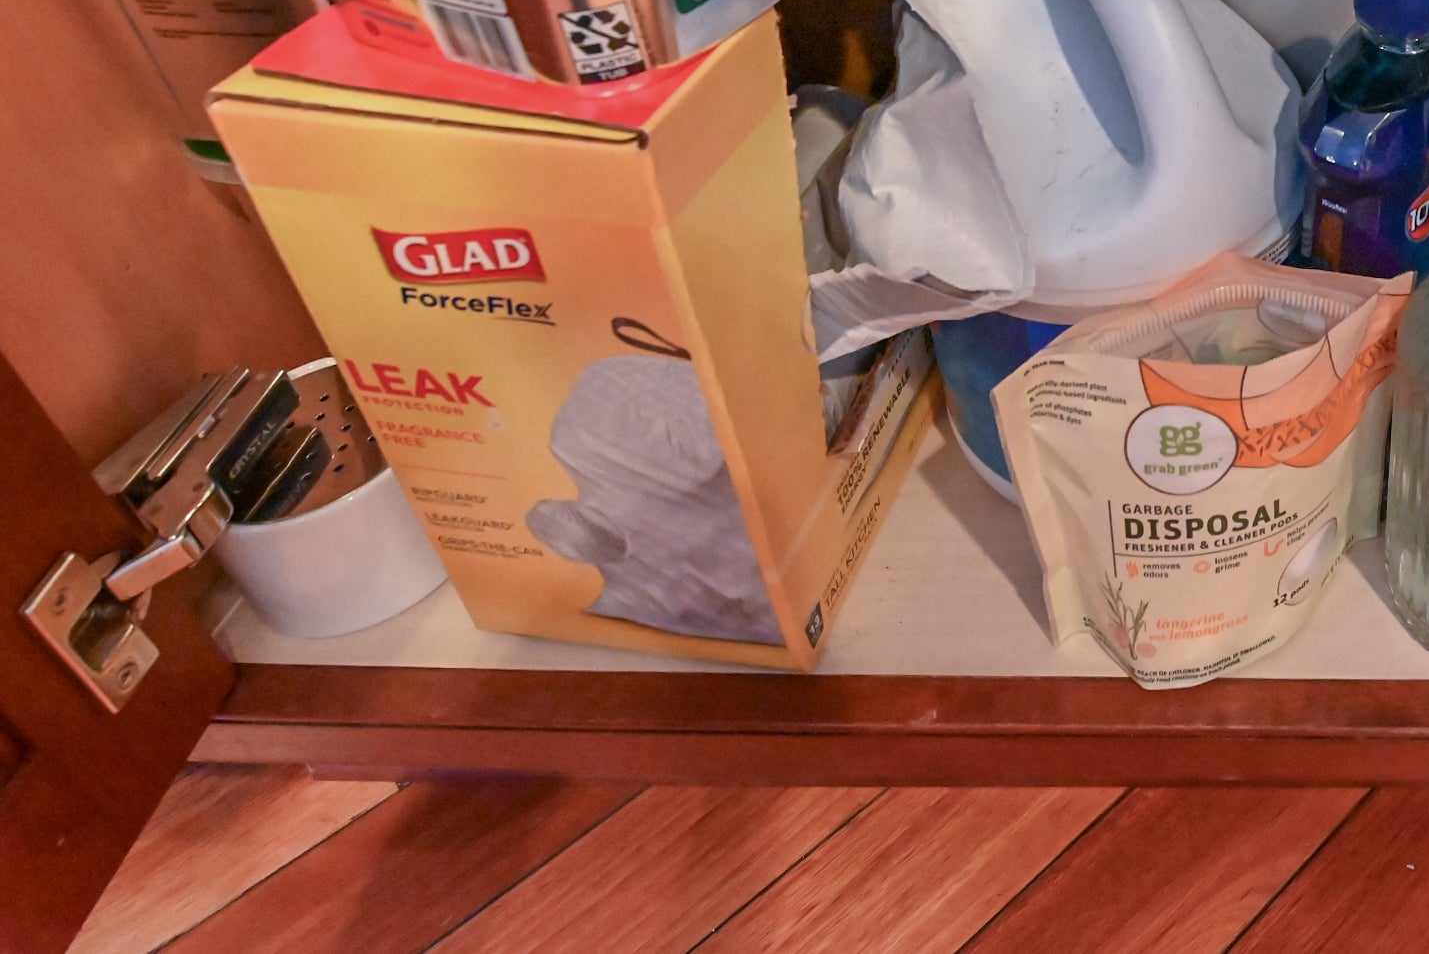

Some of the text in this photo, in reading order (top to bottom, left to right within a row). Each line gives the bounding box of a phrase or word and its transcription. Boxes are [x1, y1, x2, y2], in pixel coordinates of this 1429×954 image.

[392, 236, 531, 276] GLAD
[400, 286, 554, 321] ForceFlex
[344, 359, 497, 408] LEAK
[360, 396, 464, 417] PROTECTION
[861, 366, 911, 455] RENEWABLE
[376, 420, 485, 445] FRAGRANCE
[382, 432, 427, 448] FREE
[1160, 426, 1203, 457] gg
[1144, 462, 1218, 476] grab green
[1122, 503, 1193, 515] GARBAGE
[1124, 499, 1287, 540] DISPOSAL
[1125, 512, 1299, 552] FRESHENER & CLEANER PODS
[1287, 524, 1306, 539] helps
[824, 570, 846, 609] TALL
[845, 496, 881, 566] KITCHEN
[1214, 551, 1249, 565] loosens
[1142, 562, 1181, 571] removes
[1143, 570, 1169, 579] odors
[1214, 561, 1241, 575] grime
[1273, 578, 1309, 608] 12 pods
[1156, 612, 1225, 630] tangerine
[1169, 614, 1249, 641] lemongrass
